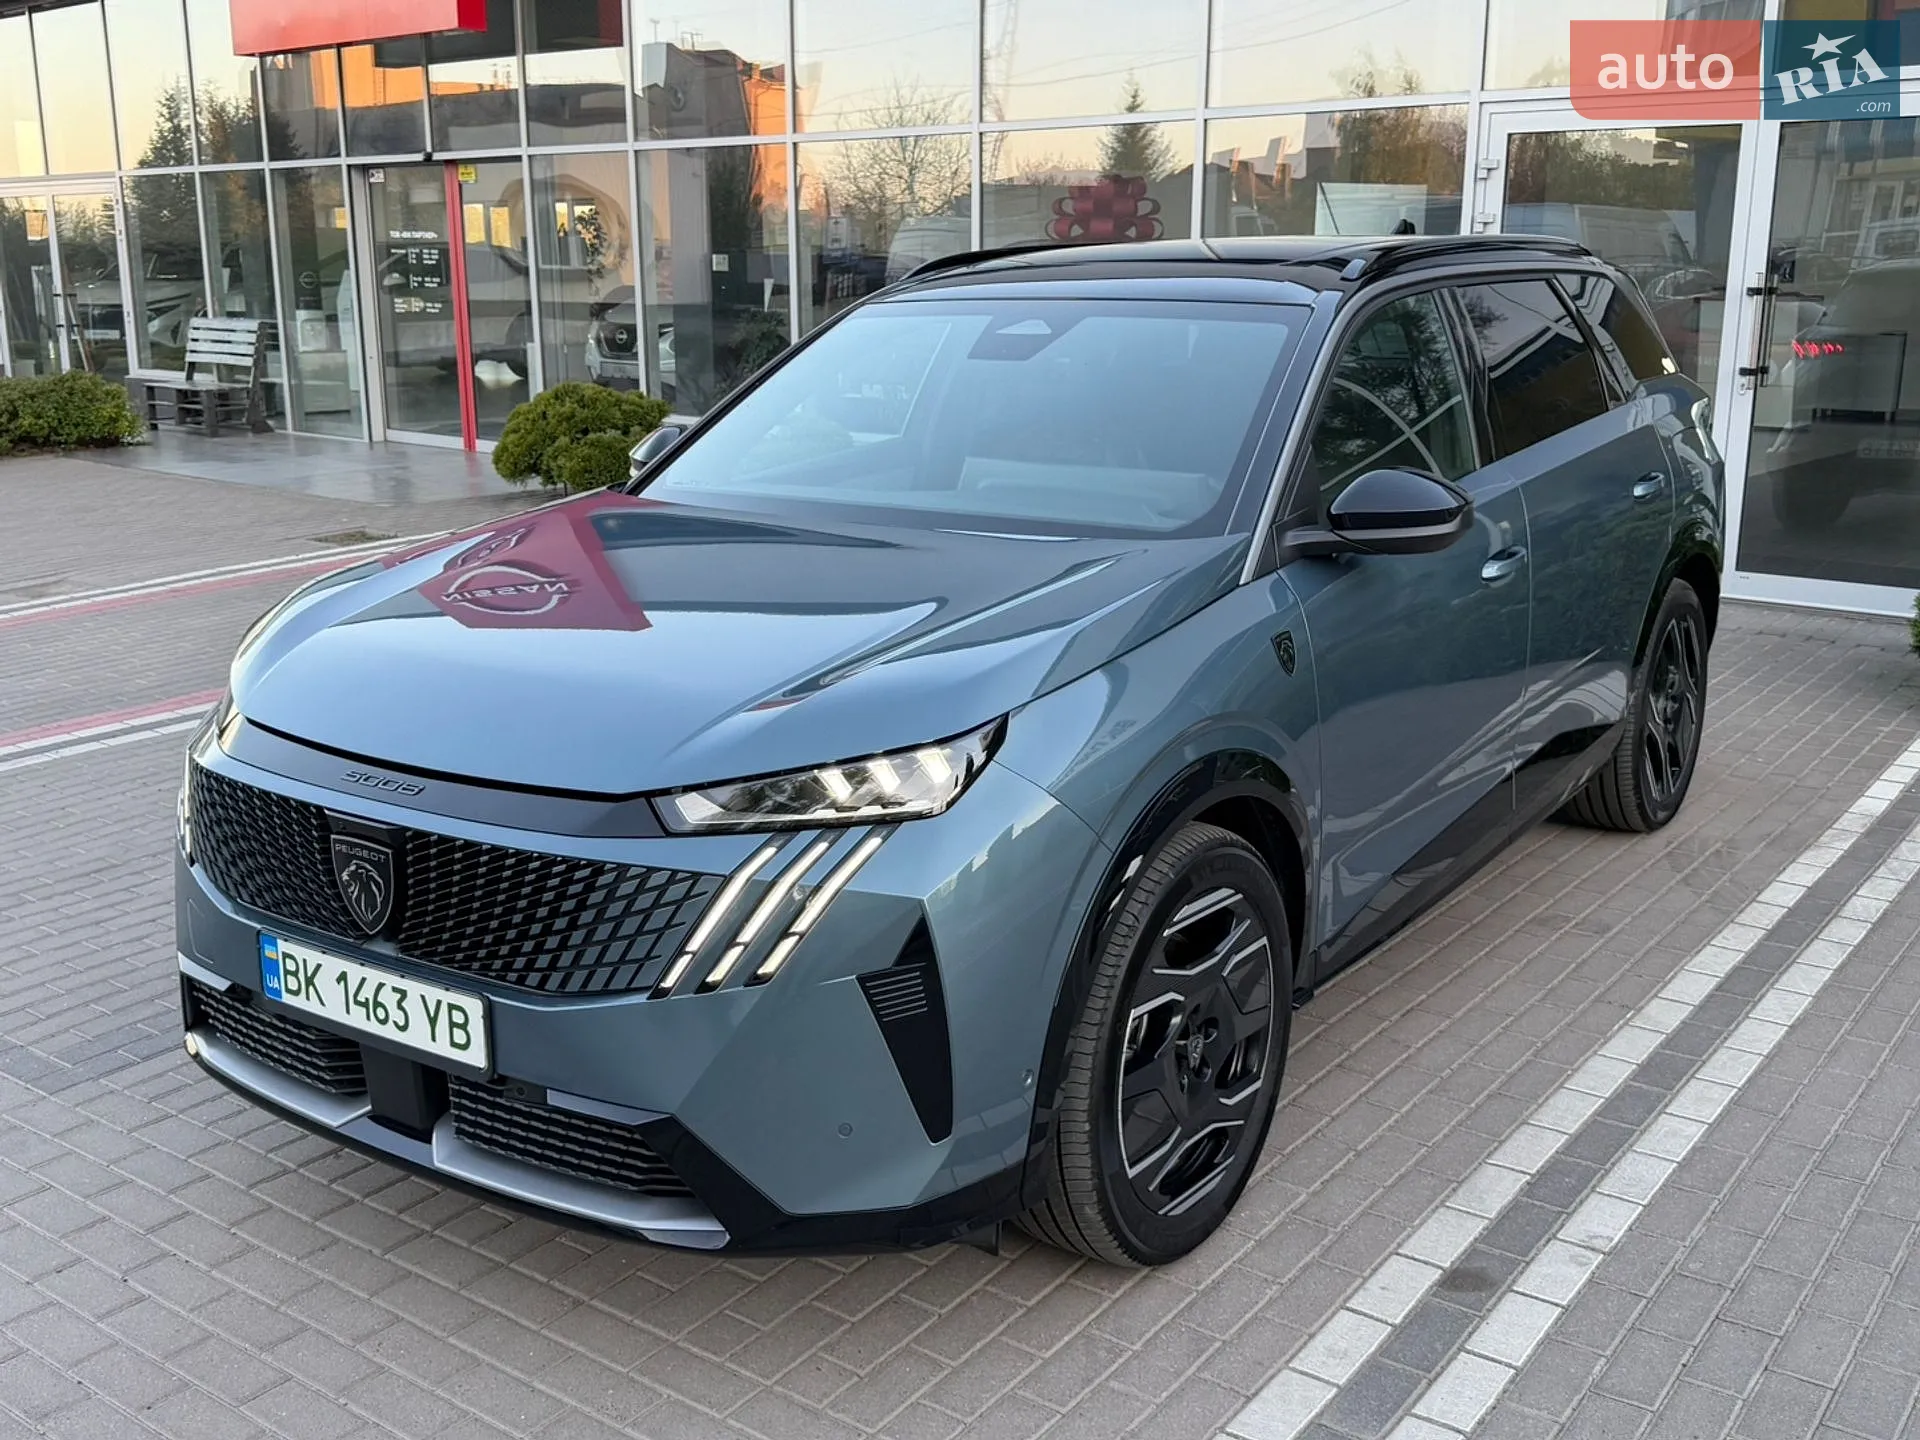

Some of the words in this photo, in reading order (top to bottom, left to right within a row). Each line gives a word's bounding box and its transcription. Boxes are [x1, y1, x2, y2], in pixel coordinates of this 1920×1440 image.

[340, 769, 426, 796] 5008
[335, 843, 386, 863] PEUGEOT
[266, 975, 280, 991] UA
[281, 950, 326, 1008] BK
[336, 970, 410, 1033] 1463
[420, 993, 471, 1051] YB
